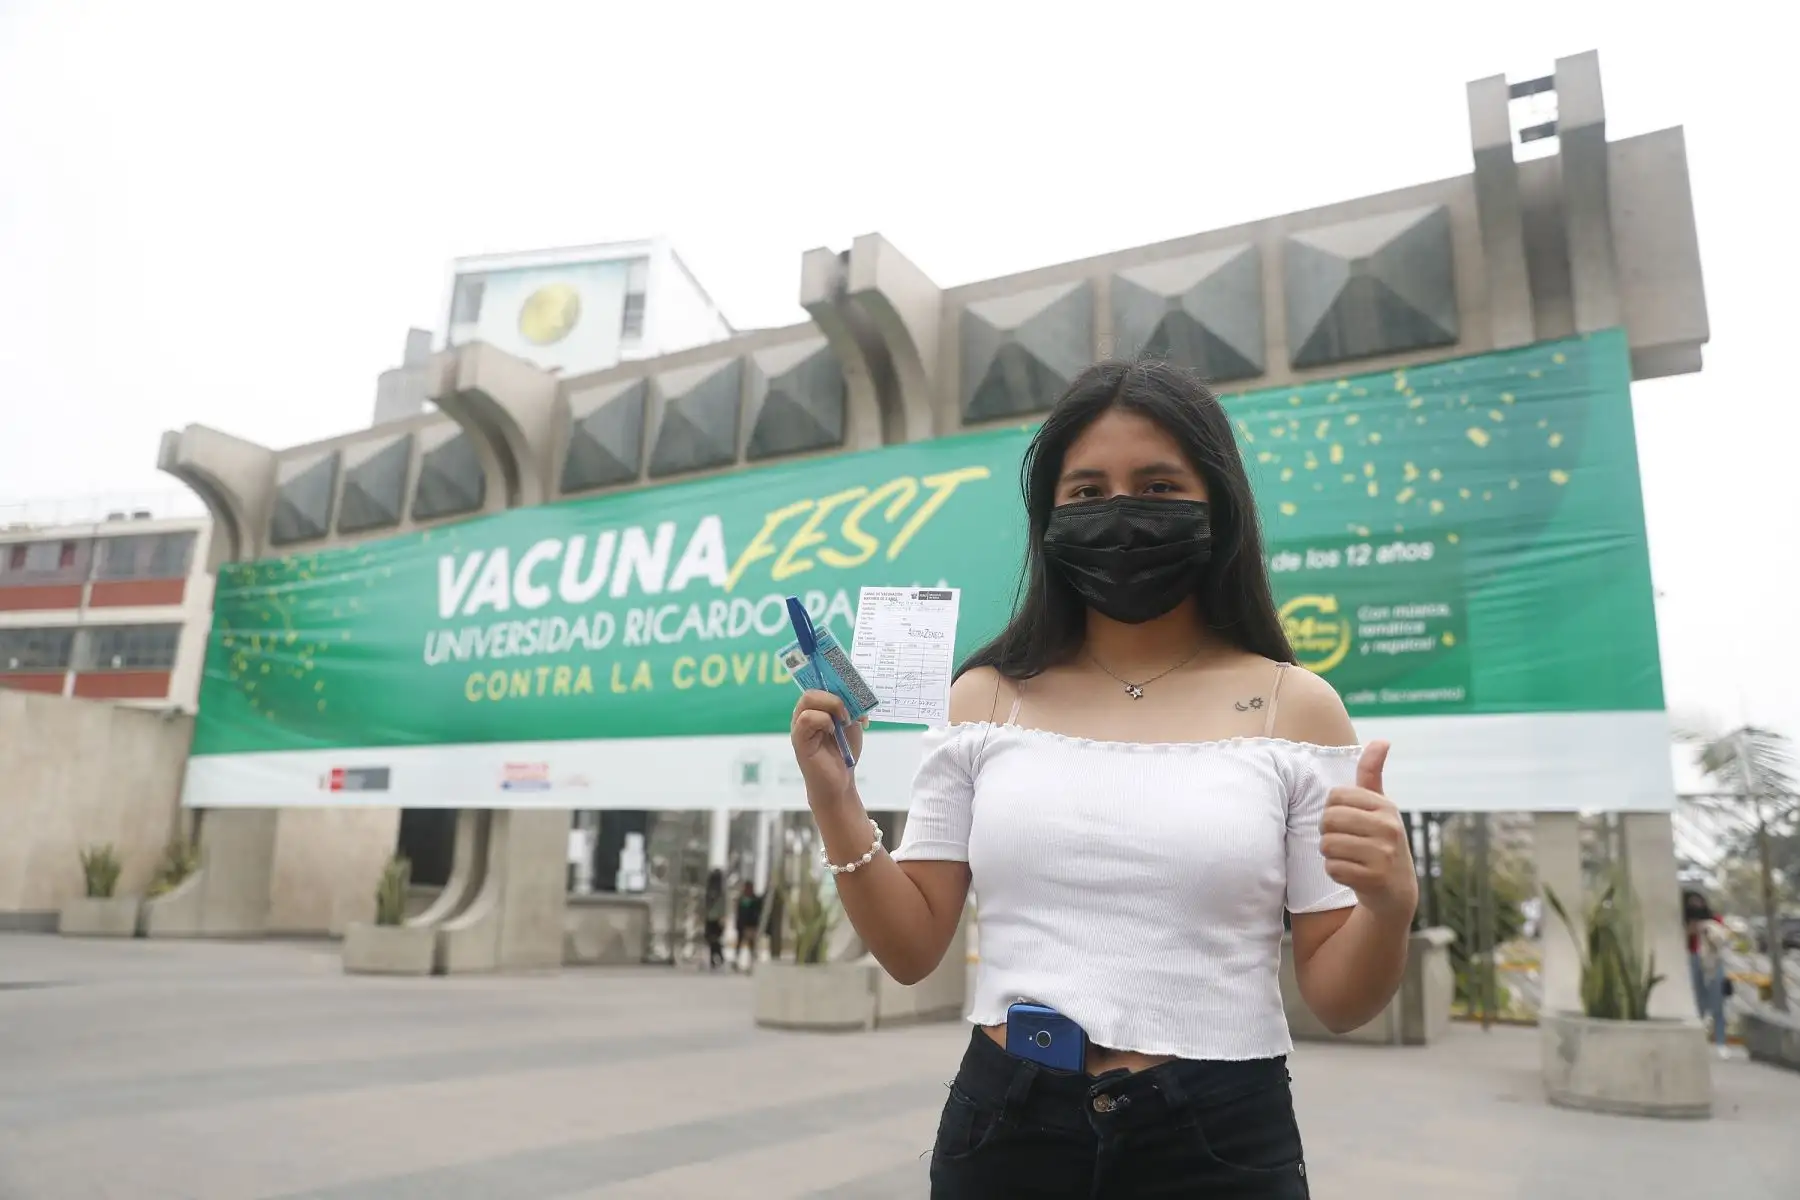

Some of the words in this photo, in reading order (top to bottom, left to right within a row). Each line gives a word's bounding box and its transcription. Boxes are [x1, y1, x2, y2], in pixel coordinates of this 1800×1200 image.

[1271, 550, 1302, 573] de
[1305, 547, 1341, 570] los
[1345, 542, 1372, 567] 12
[1376, 541, 1435, 565] años
[423, 611, 616, 666] UNIVERSIDAD
[622, 593, 790, 647] RICARDO
[465, 664, 595, 702] CONTRA
[611, 659, 653, 694] LA
